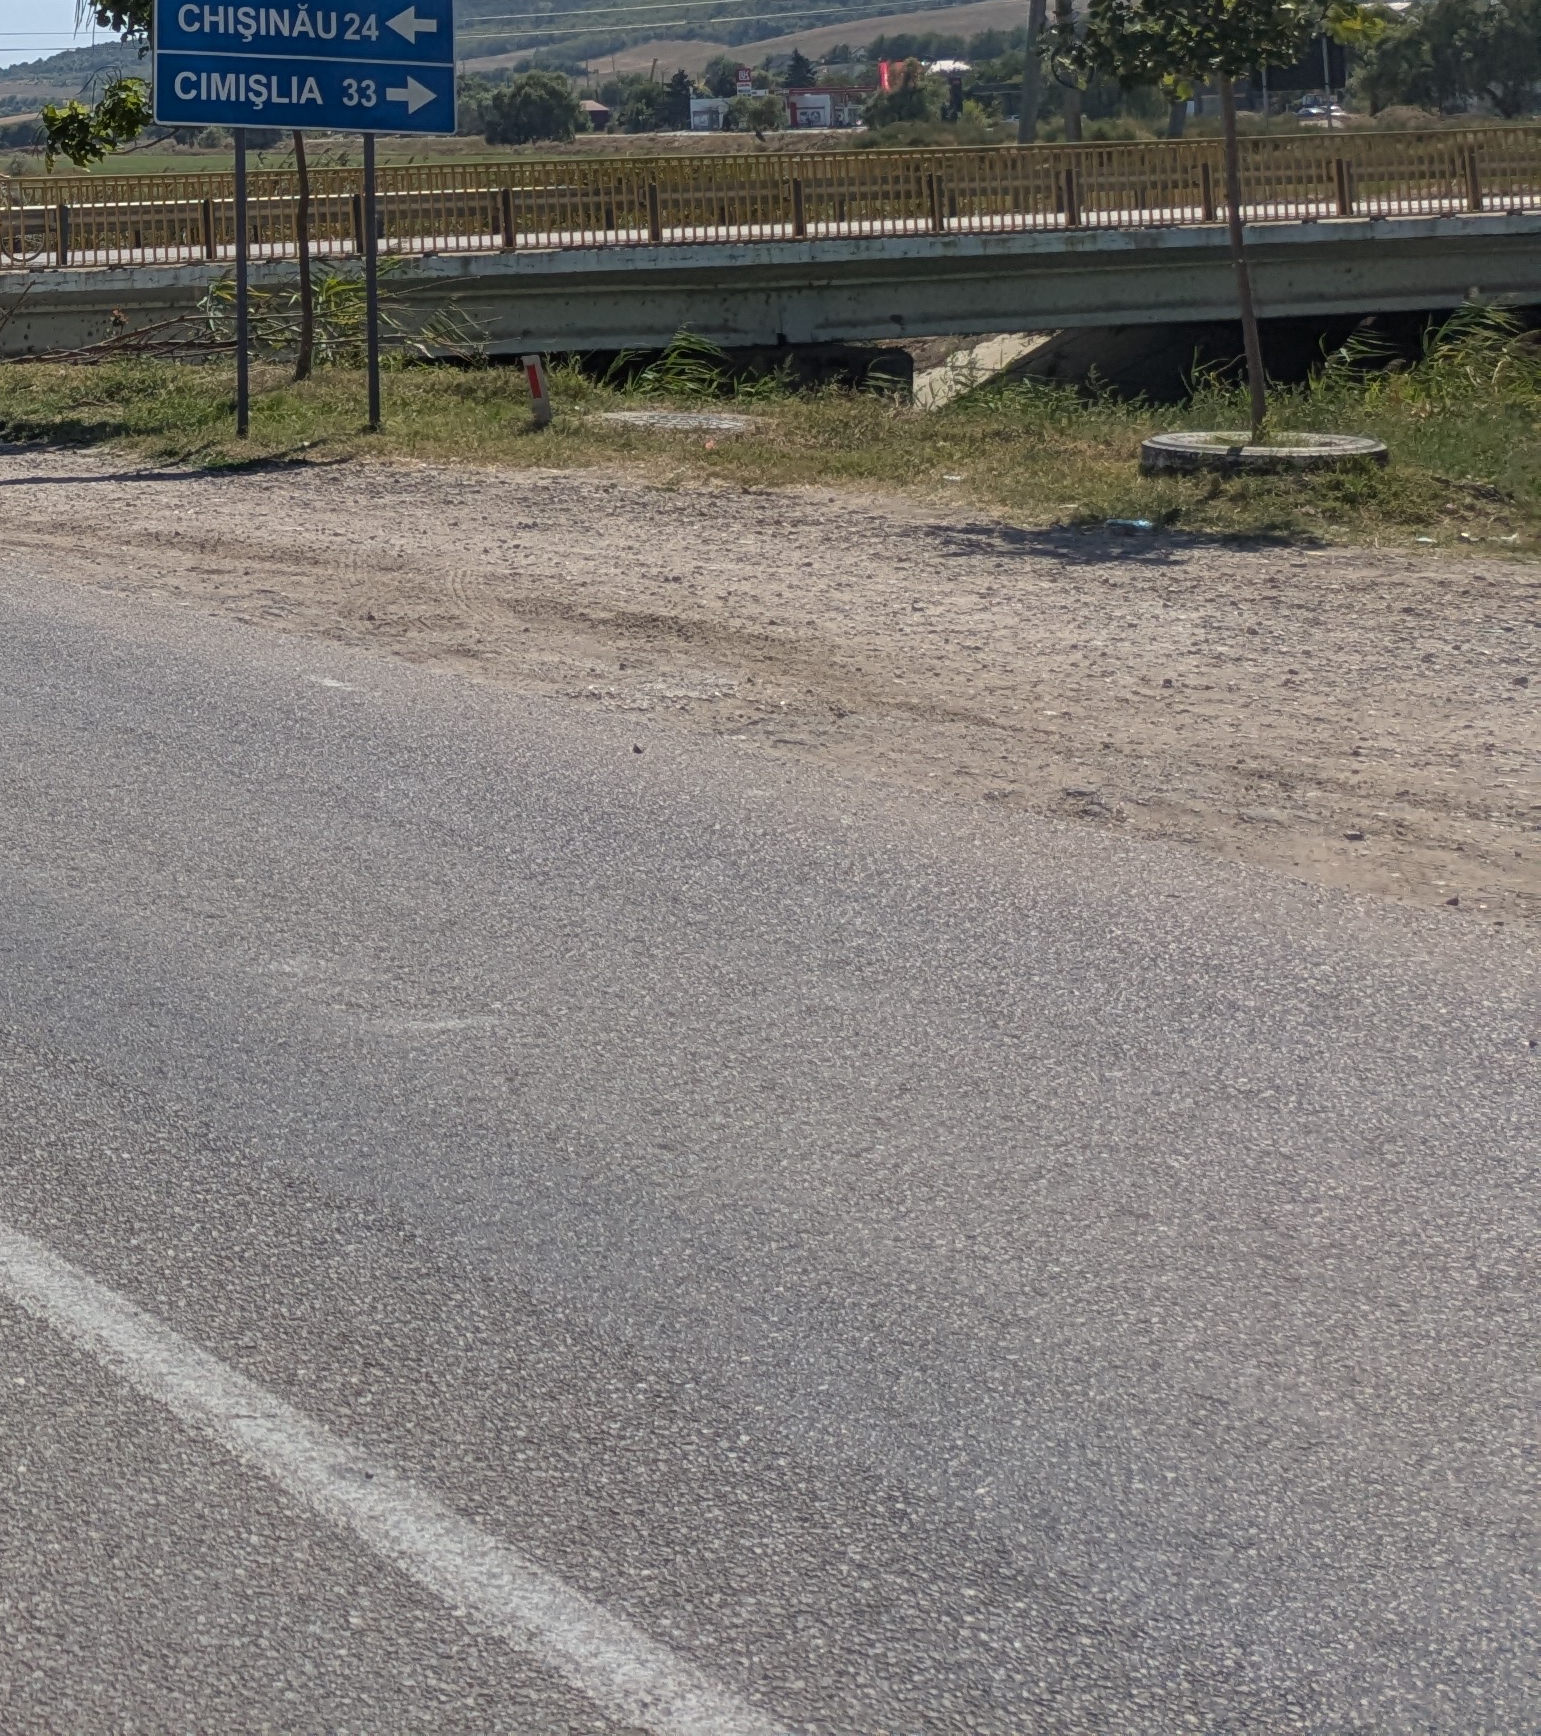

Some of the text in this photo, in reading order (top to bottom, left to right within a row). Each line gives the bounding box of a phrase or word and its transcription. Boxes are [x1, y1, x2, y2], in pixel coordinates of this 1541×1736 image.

[178, 3, 380, 42] CHIŞINĂU 24
[174, 71, 377, 110] CIMIŞLIA 33
